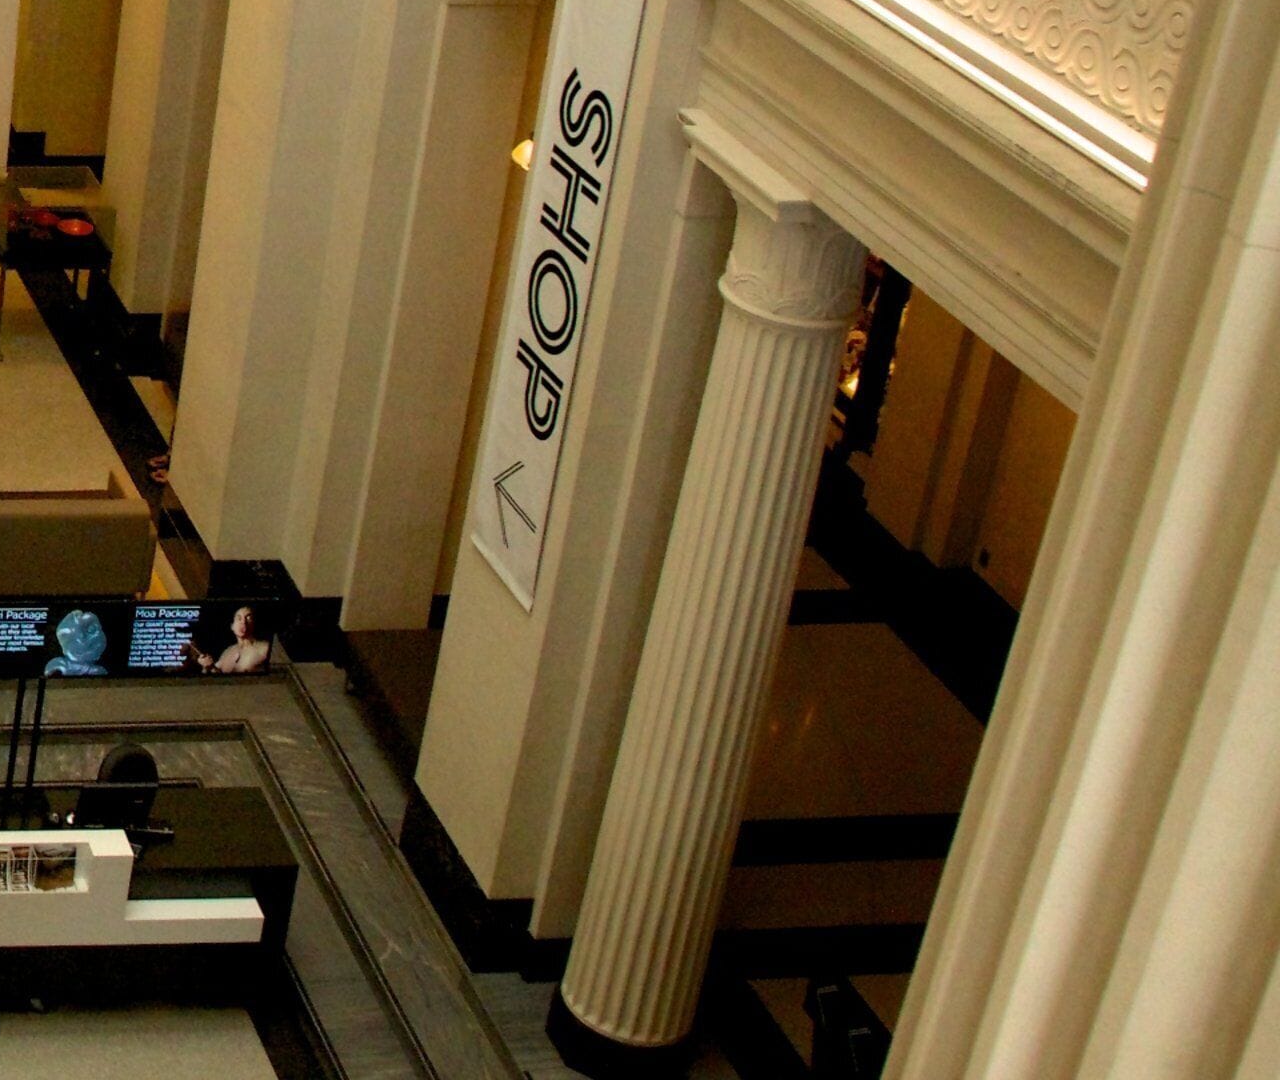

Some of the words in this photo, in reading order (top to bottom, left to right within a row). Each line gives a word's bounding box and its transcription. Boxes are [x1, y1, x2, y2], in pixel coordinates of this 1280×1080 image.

[517, 67, 613, 441] SHOP
[6, 610, 48, 621] Package
[135, 609, 157, 618] Moa
[159, 608, 200, 619] Package
